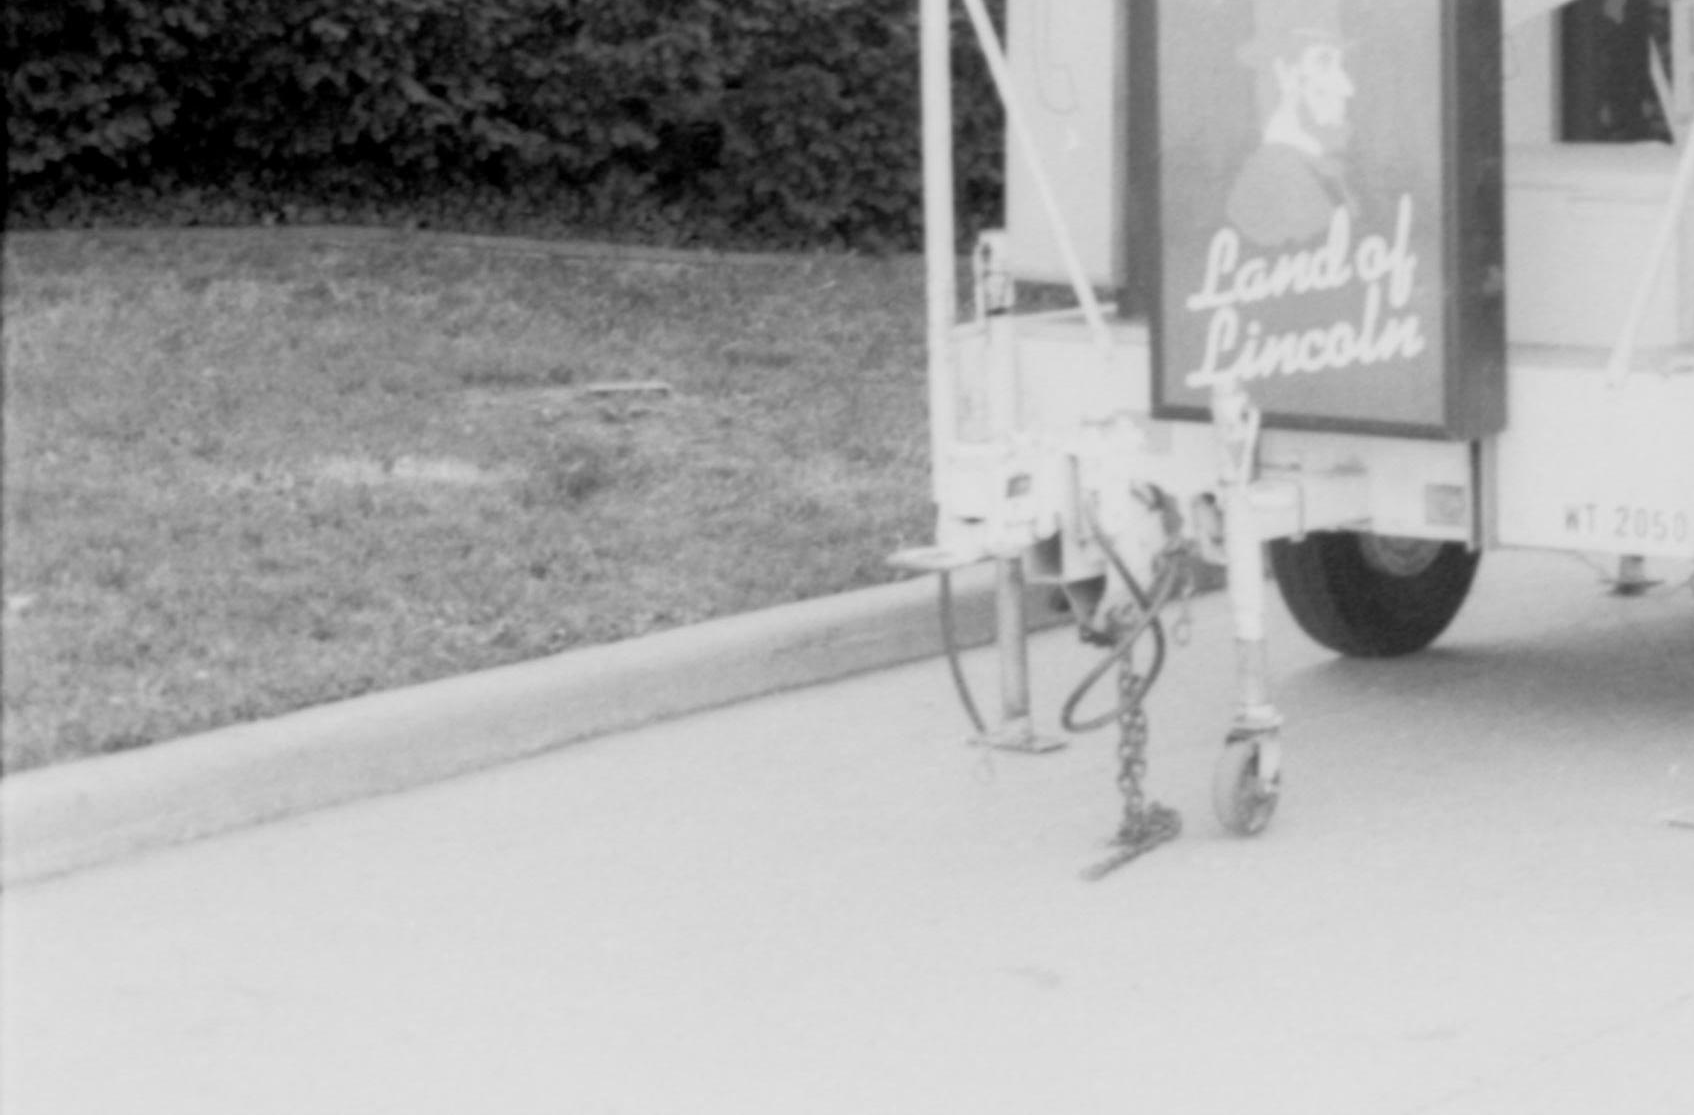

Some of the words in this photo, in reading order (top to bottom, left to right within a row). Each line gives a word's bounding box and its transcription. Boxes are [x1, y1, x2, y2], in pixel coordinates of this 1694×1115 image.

[1186, 205, 1354, 311] Land
[1354, 191, 1418, 308] of
[1185, 284, 1425, 387] Lincoln
[1563, 502, 1598, 534] WT
[1613, 504, 1689, 543] 2050
